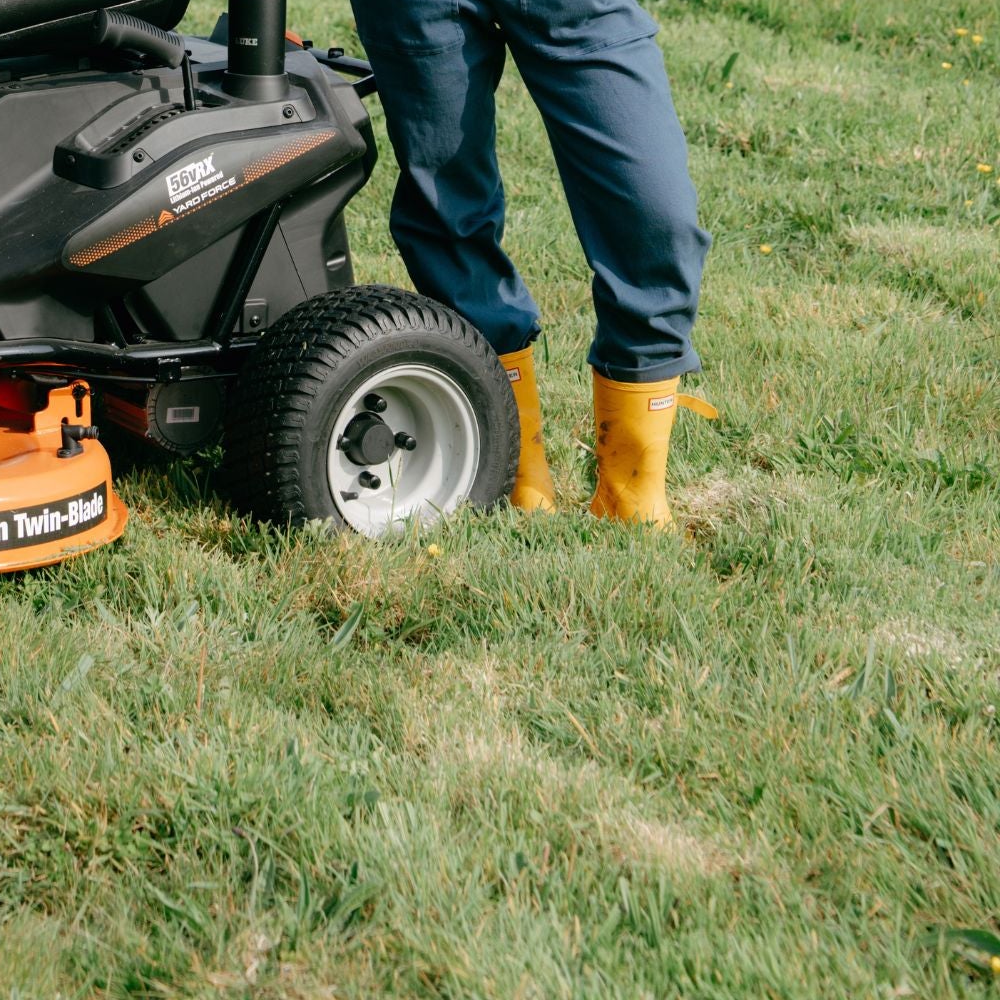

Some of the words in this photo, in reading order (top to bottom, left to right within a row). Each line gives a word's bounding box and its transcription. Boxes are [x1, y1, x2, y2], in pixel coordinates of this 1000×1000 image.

[172, 196, 201, 214] YARD
[201, 176, 237, 201] FORCE
[200, 170, 224, 189] Powered
[13, 491, 104, 539] Twin-Blade
